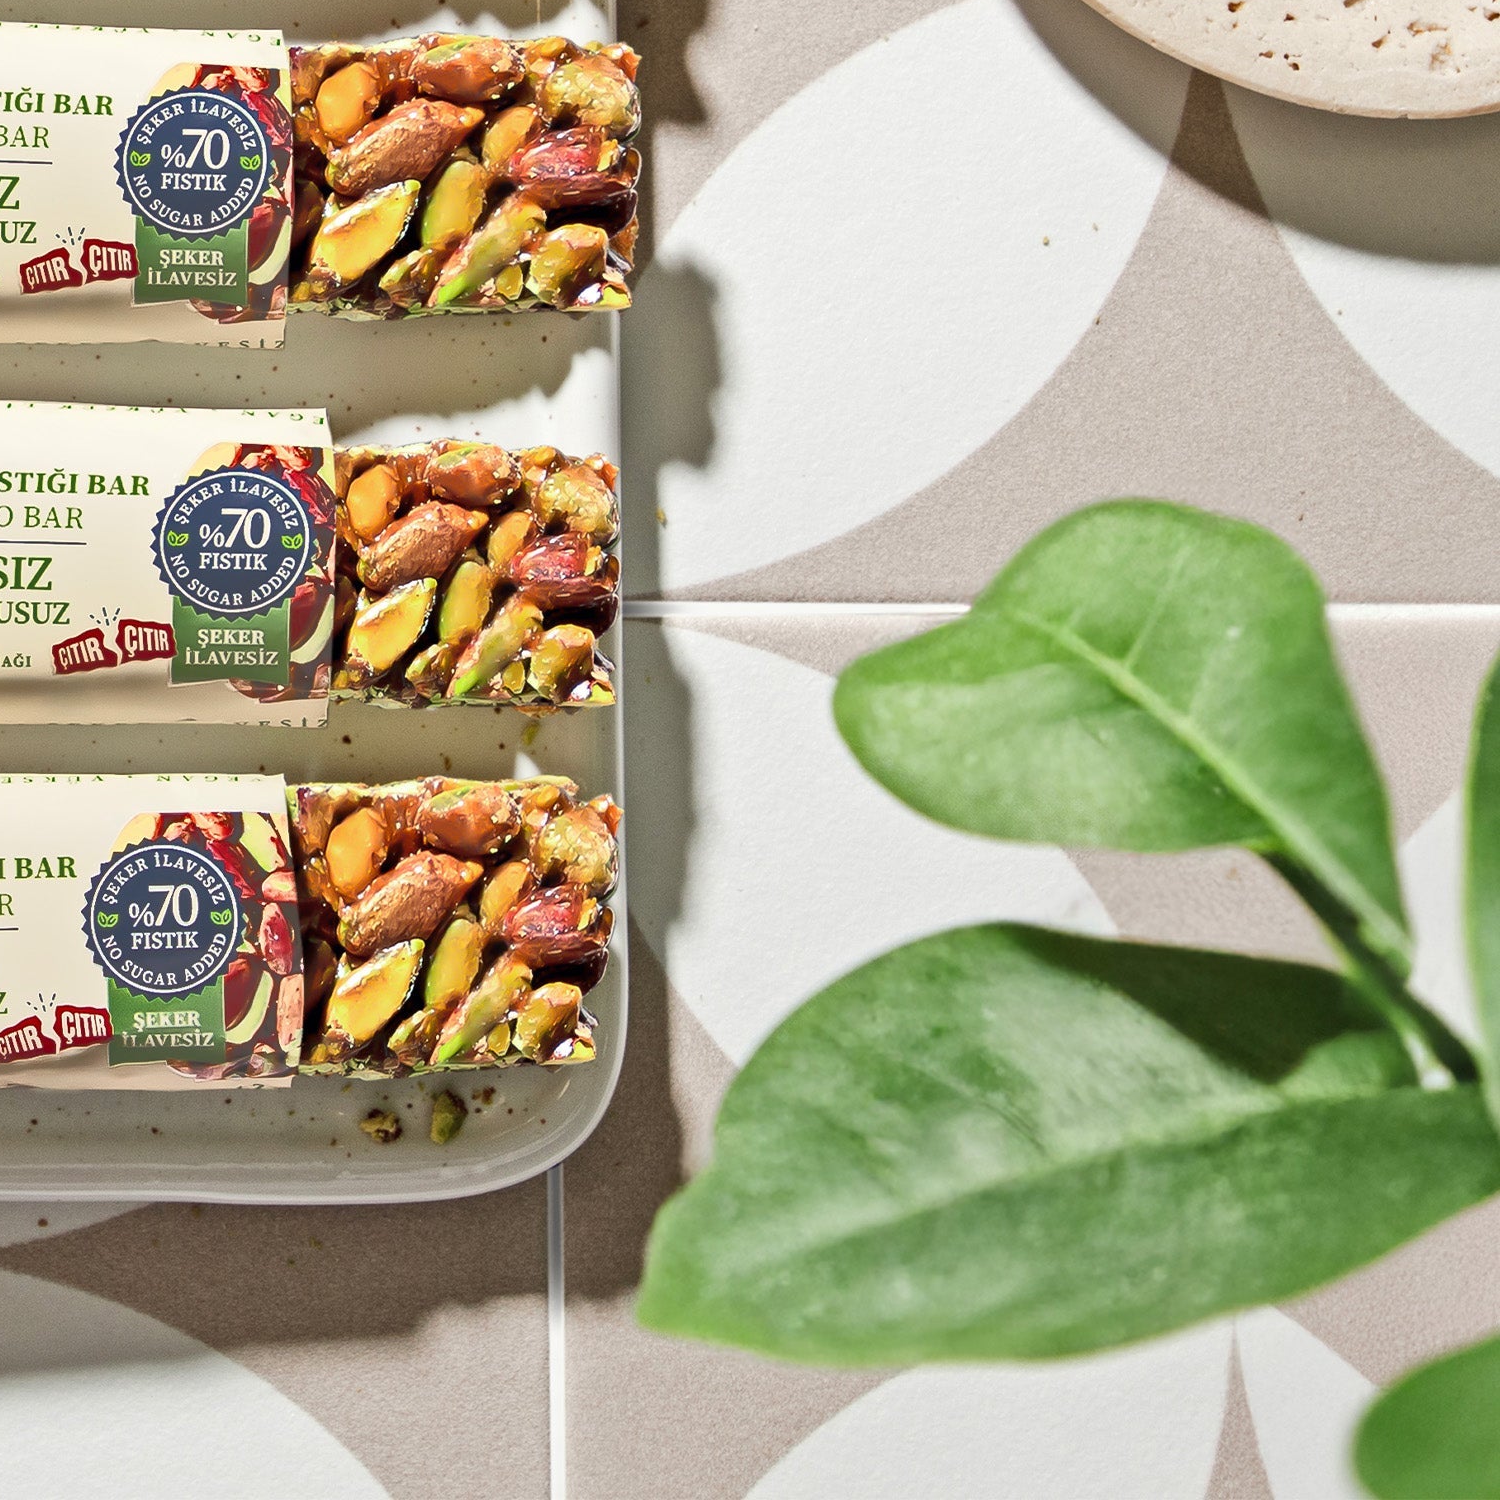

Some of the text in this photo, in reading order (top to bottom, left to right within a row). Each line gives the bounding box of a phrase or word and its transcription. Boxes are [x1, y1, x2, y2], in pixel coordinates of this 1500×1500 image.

[53, 94, 113, 116] BAR
[161, 129, 230, 169] %70
[161, 173, 227, 191] FISTIK
[131, 172, 255, 228] NO SUGAR ADDED
[26, 245, 131, 289] ÇITIR ÇITIR
[160, 249, 223, 268] ŞEKER
[148, 267, 237, 286] İLAVESİZ
[87, 474, 149, 496] BAR
[23, 506, 83, 529] BAR
[199, 508, 271, 548] %70
[199, 553, 267, 570] FISTIK
[168, 552, 297, 607] NO SUGAR ADDED
[59, 625, 169, 669] ÇITIR ÇITIR
[198, 629, 264, 648] ŞEKER
[186, 647, 278, 665] İLAVESİZ
[14, 856, 77, 879] BAR
[100, 850, 228, 907] ŞEKER İLAVESİZ
[129, 884, 198, 927] %70
[131, 931, 198, 949] FISTIK
[100, 932, 229, 988] NO SUGAR ADDED
[62, 1012, 106, 1044] ÇITIR
[131, 1010, 202, 1032] ŞEKER
